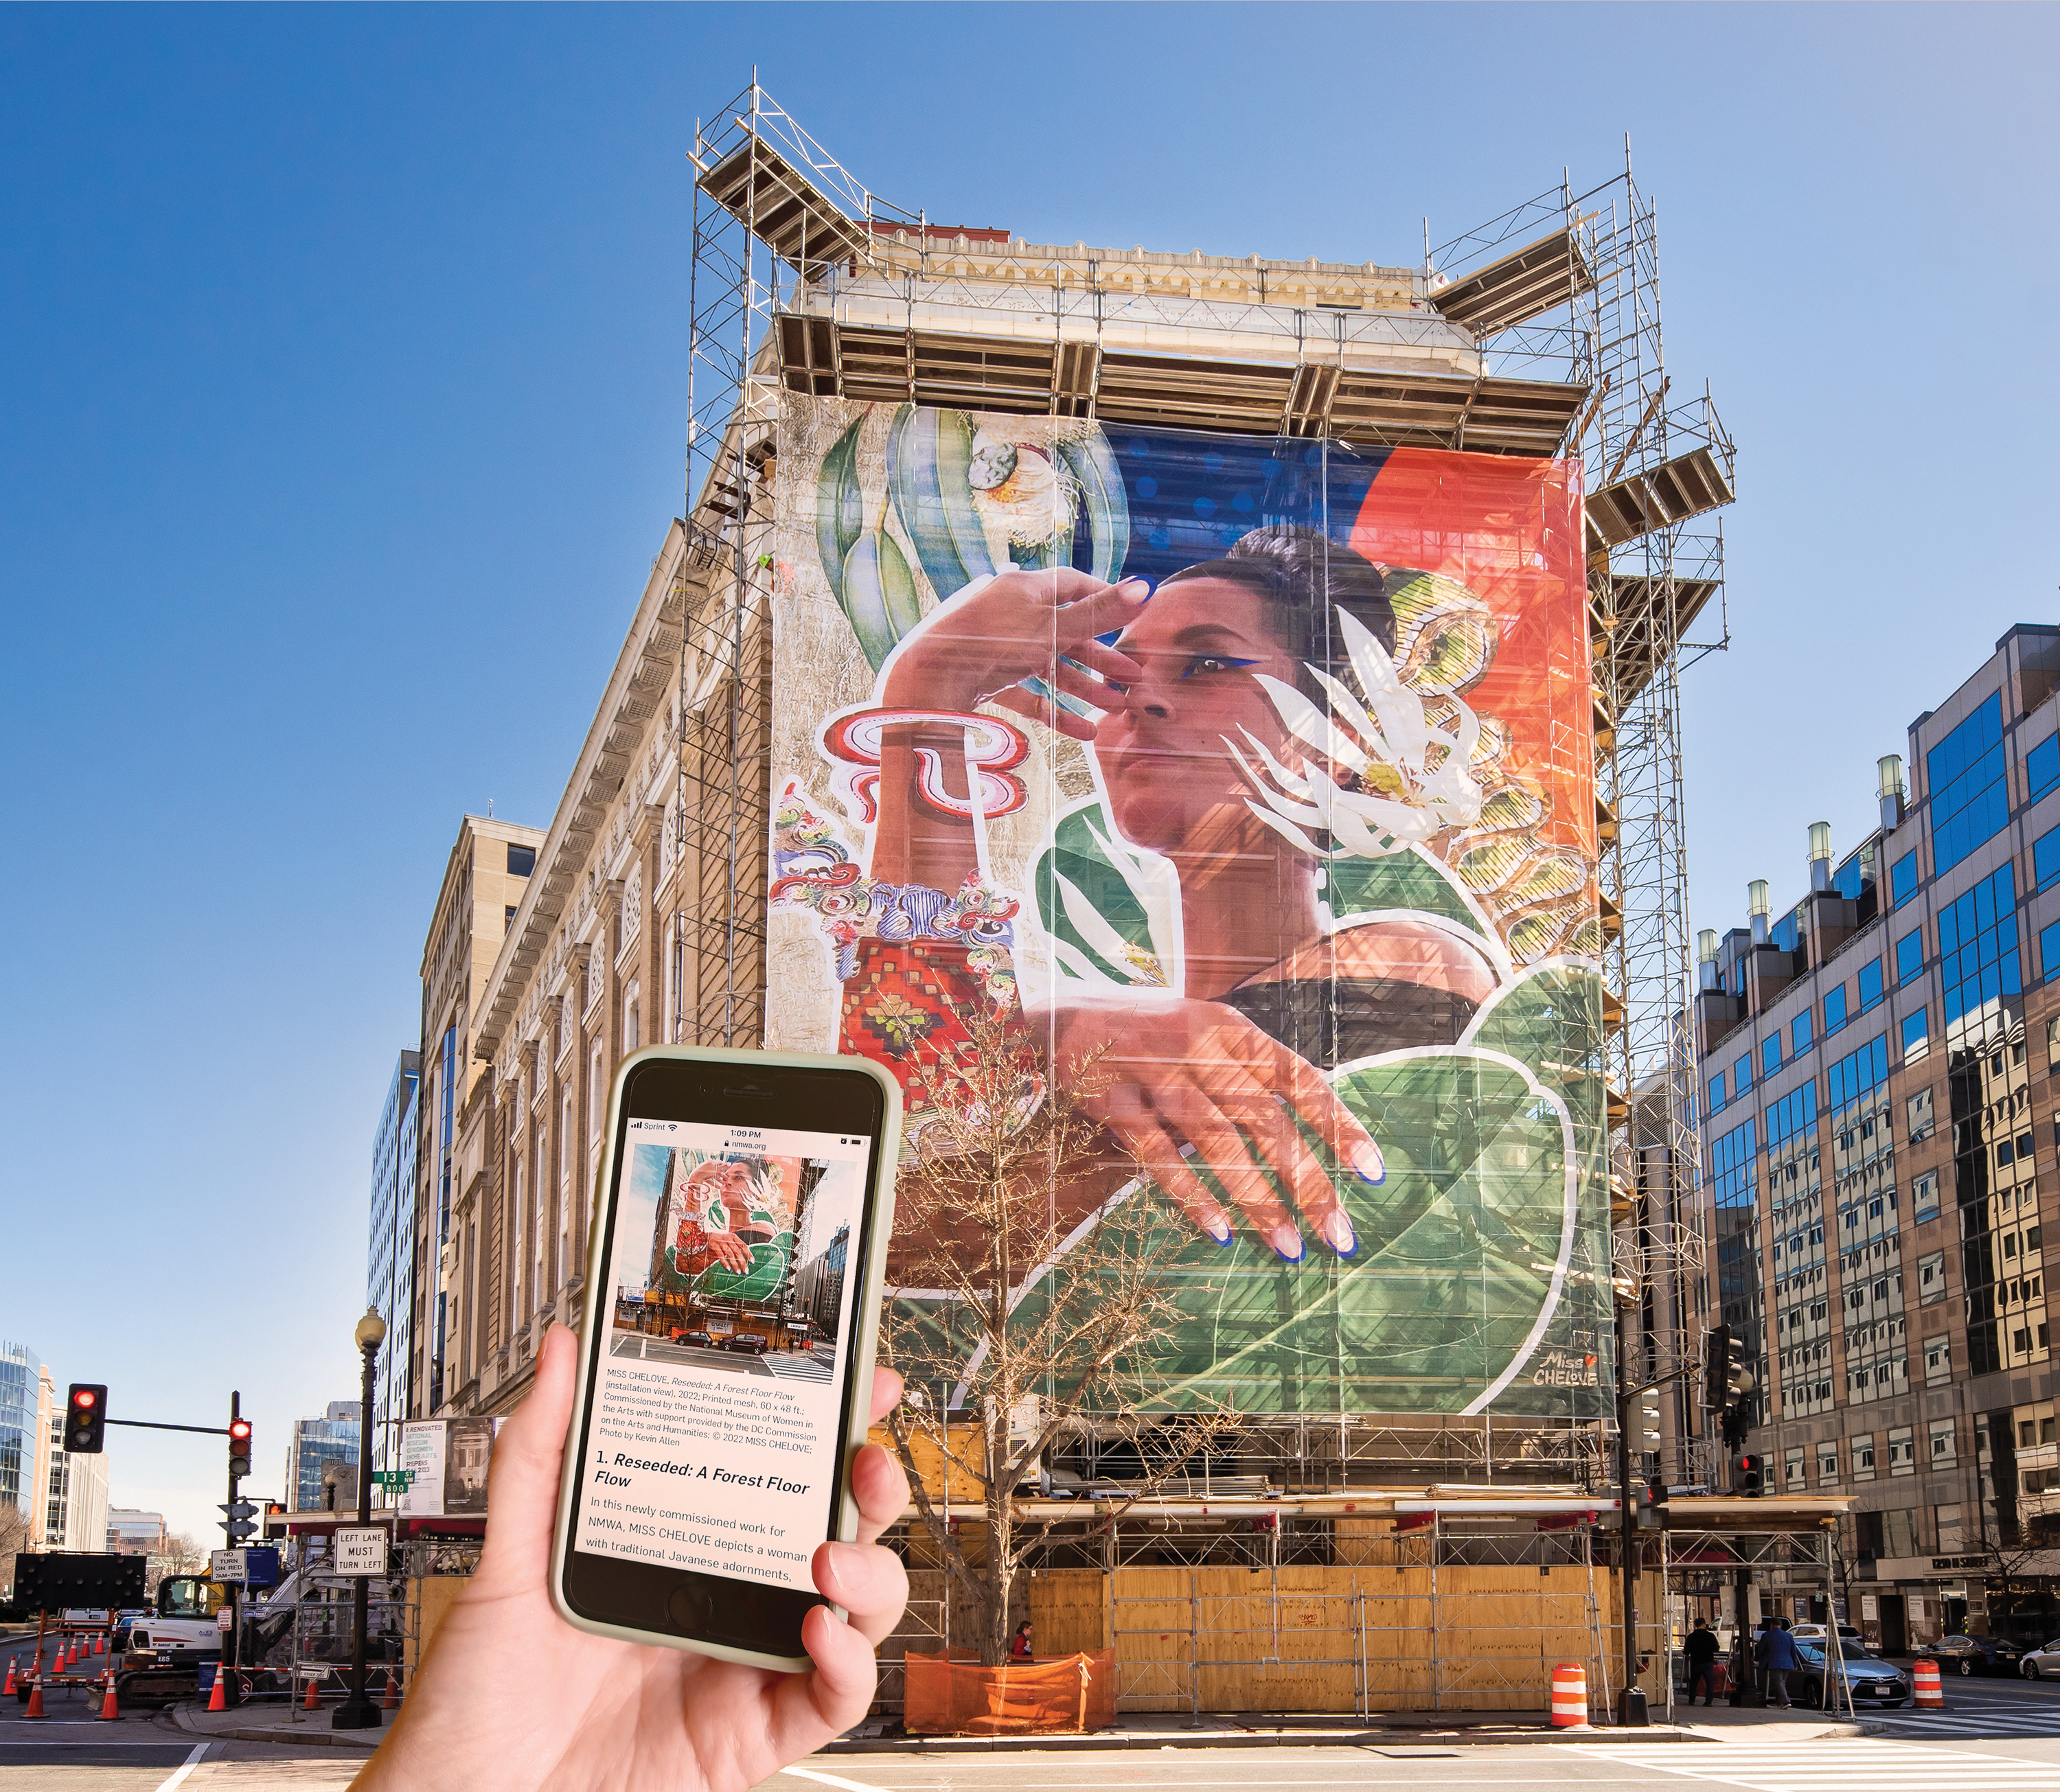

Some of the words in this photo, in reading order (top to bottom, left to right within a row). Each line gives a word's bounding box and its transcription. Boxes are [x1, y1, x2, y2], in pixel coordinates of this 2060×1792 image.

[644, 1122, 665, 1131] Sprint
[732, 1141, 766, 1150] nmwa.org
[1540, 1351, 1583, 1369] Miss
[607, 1368, 627, 1378] MISS
[629, 1372, 669, 1384] CHELOVE,
[672, 1377, 713, 1390] Reseeded:
[722, 1384, 748, 1394] Forest
[750, 1388, 773, 1397] Floor
[774, 1391, 795, 1401] Flow
[1533, 1369, 1599, 1386] CHELOVE
[604, 1392, 661, 1407] Commissioned
[663, 1401, 672, 1410] by
[675, 1402, 687, 1411] the
[689, 1404, 722, 1416] National
[725, 1409, 759, 1421] Museum
[772, 1416, 803, 1427] Women
[805, 1420, 813, 1428] in
[606, 1381, 651, 1394] (installation
[654, 1388, 676, 1398] view),
[678, 1390, 700, 1401] 2022;
[702, 1393, 731, 1405] Printed
[734, 1400, 757, 1409] mesh,
[760, 1401, 771, 1410] 60
[780, 1405, 791, 1413] 48
[794, 1406, 804, 1415] ft.;
[599, 1427, 622, 1438] Photo
[624, 1431, 634, 1441] by
[635, 1433, 656, 1443] Kevin
[659, 1436, 680, 1446] Allen
[603, 1404, 615, 1413] the
[617, 1406, 634, 1415] Arts
[636, 1410, 653, 1418] with
[655, 1413, 685, 1423] support
[687, 1418, 722, 1427] provided
[724, 1421, 733, 1431] by
[736, 1423, 749, 1432] the
[751, 1425, 764, 1434] DC
[766, 1427, 816, 1441] Commission
[613, 1418, 626, 1426] the
[627, 1420, 644, 1429] Arts
[663, 1425, 710, 1439] Humanities;
[723, 1433, 744, 1443] 2022
[746, 1436, 766, 1447] MISS
[769, 1440, 812, 1454] CHELOVE;
[384, 1472, 396, 1482] 13
[595, 1470, 632, 1487] Flow
[596, 1450, 608, 1464] 1.
[614, 1453, 694, 1477] Reseeded:
[696, 1466, 707, 1479] A
[712, 1468, 764, 1488] Forest
[766, 1476, 810, 1495] Floor
[591, 1496, 599, 1506] In
[604, 1499, 622, 1510] this
[626, 1504, 656, 1518] newly
[659, 1510, 736, 1529] commissioned
[740, 1523, 766, 1534] work
[770, 1526, 786, 1537] for
[348, 1547, 374, 1556] MUST
[588, 1516, 625, 1532] NMWA,
[629, 1523, 656, 1537] MISS
[659, 1528, 711, 1546] CHELOVE
[714, 1538, 753, 1553] depicts
[768, 1548, 807, 1562] woman
[586, 1537, 608, 1549] with
[611, 1541, 665, 1559] traditional
[668, 1551, 719, 1568] Javanese
[722, 1561, 791, 1583] adornments,
